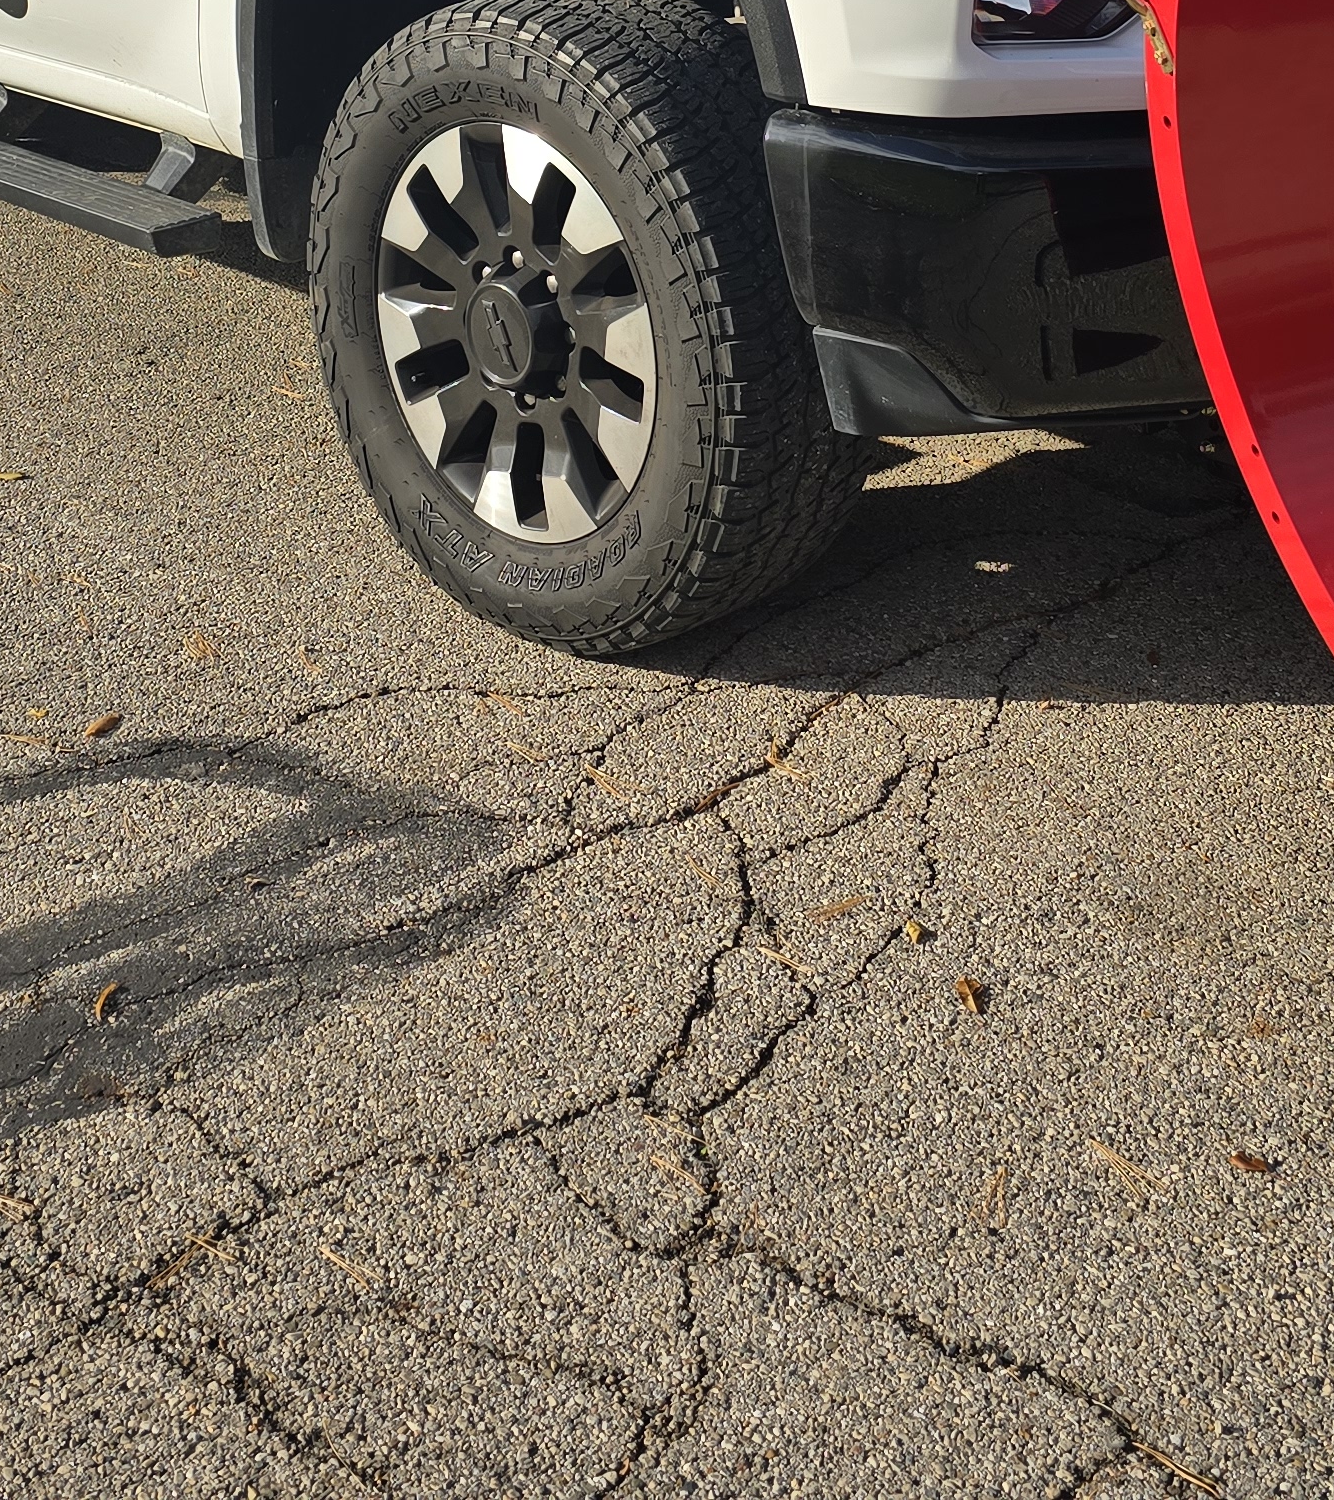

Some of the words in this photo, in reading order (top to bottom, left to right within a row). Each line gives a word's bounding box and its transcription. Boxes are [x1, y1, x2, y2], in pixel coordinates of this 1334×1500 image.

[387, 79, 541, 135] NEXEN
[408, 492, 496, 573] ATX
[497, 509, 642, 592] ROADIAN
